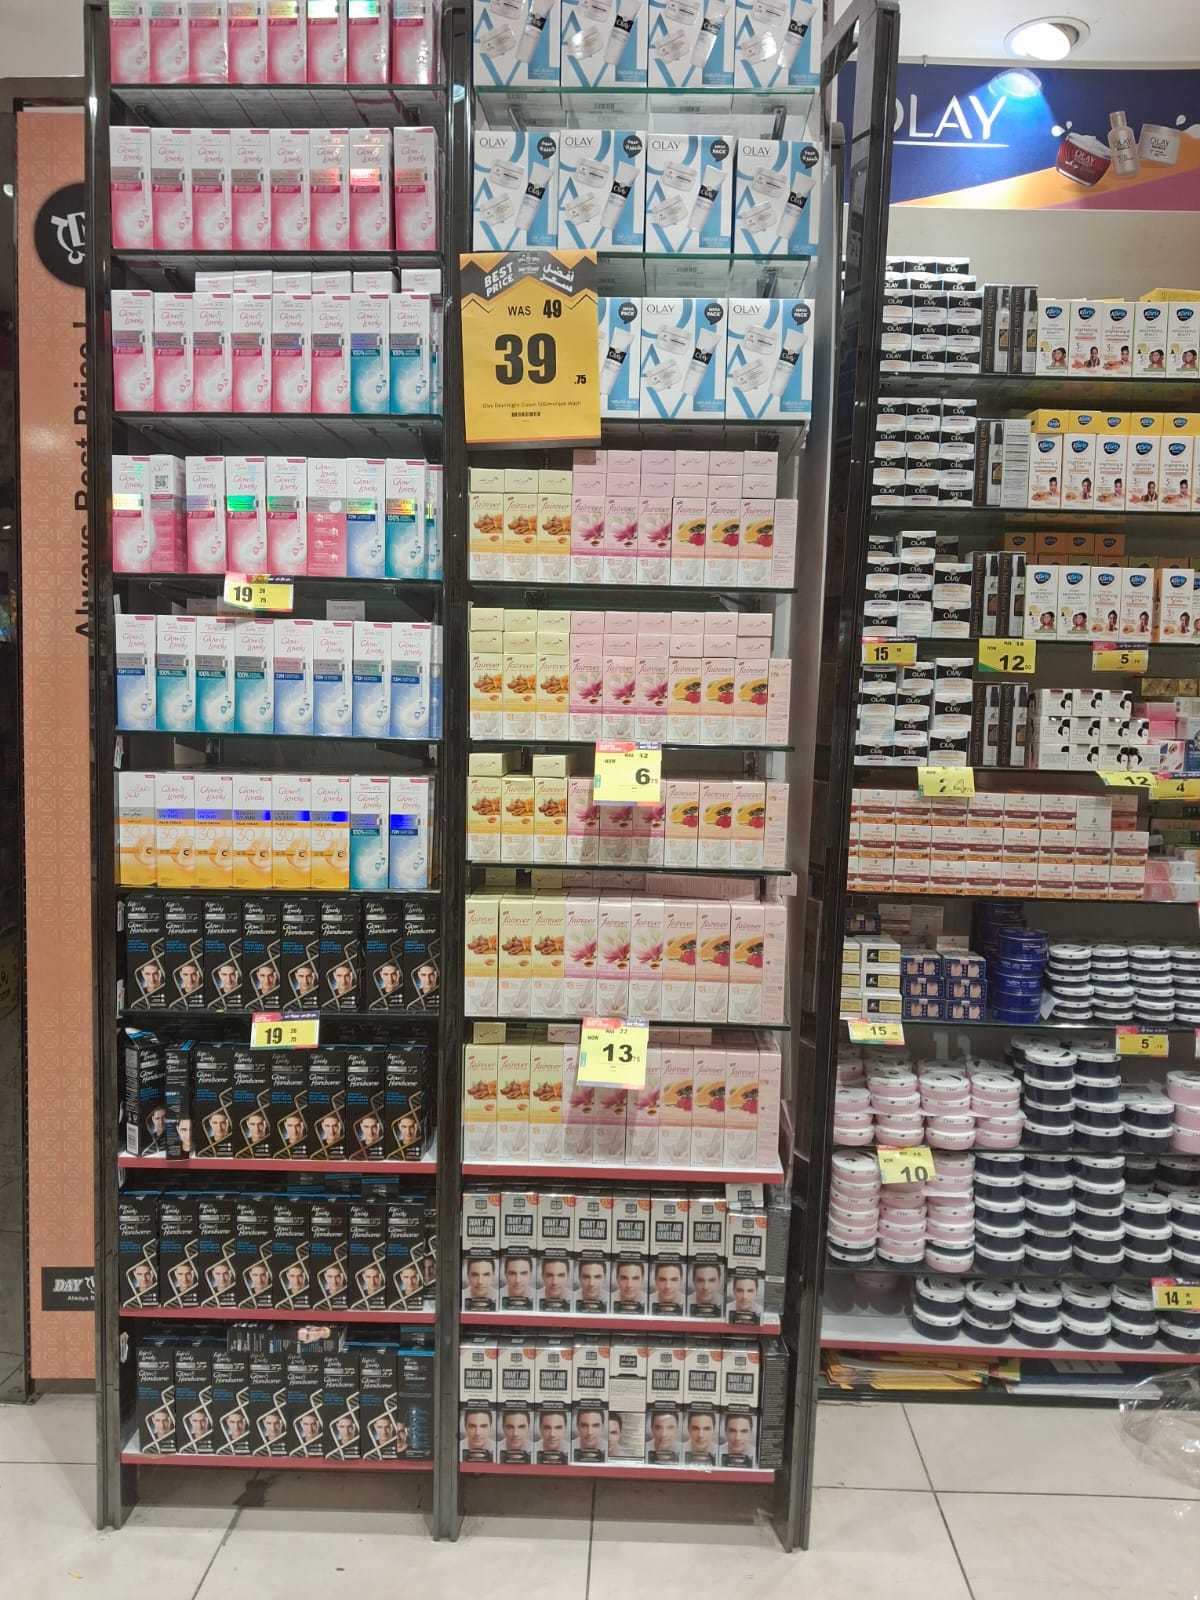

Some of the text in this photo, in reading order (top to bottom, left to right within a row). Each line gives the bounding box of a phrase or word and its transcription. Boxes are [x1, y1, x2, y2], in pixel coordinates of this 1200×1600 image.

[894, 94, 1007, 140] LAY
[479, 137, 508, 147] OLAY
[565, 136, 593, 146] OLAY
[652, 140, 681, 150] OLAY
[742, 145, 771, 155] OLAY
[484, 262, 514, 288] BEST
[486, 273, 515, 297] PRICE
[507, 299, 562, 318] WAS 49
[646, 304, 676, 314] OLAY
[733, 304, 763, 314] OLAY
[495, 333, 587, 385] 39 .75
[73, 342, 88, 426] Price
[74, 437, 88, 511] Best
[233, 586, 253, 602] 19
[873, 646, 889, 661] 15
[1120, 653, 1129, 664] 5
[1000, 655, 1025, 671] 12
[635, 768, 651, 785] 6
[1124, 776, 1152, 786] 12
[1176, 782, 1185, 792] 4
[199, 828, 217, 841] 30
[237, 829, 255, 841] 30
[265, 1027, 283, 1044] 19
[870, 1026, 887, 1036] 15
[1142, 1038, 1149, 1049] 5
[602, 1043, 633, 1063] 13
[901, 1165, 928, 1184] 10
[53, 1278, 84, 1293] DAY
[1164, 1291, 1179, 1306] 14
